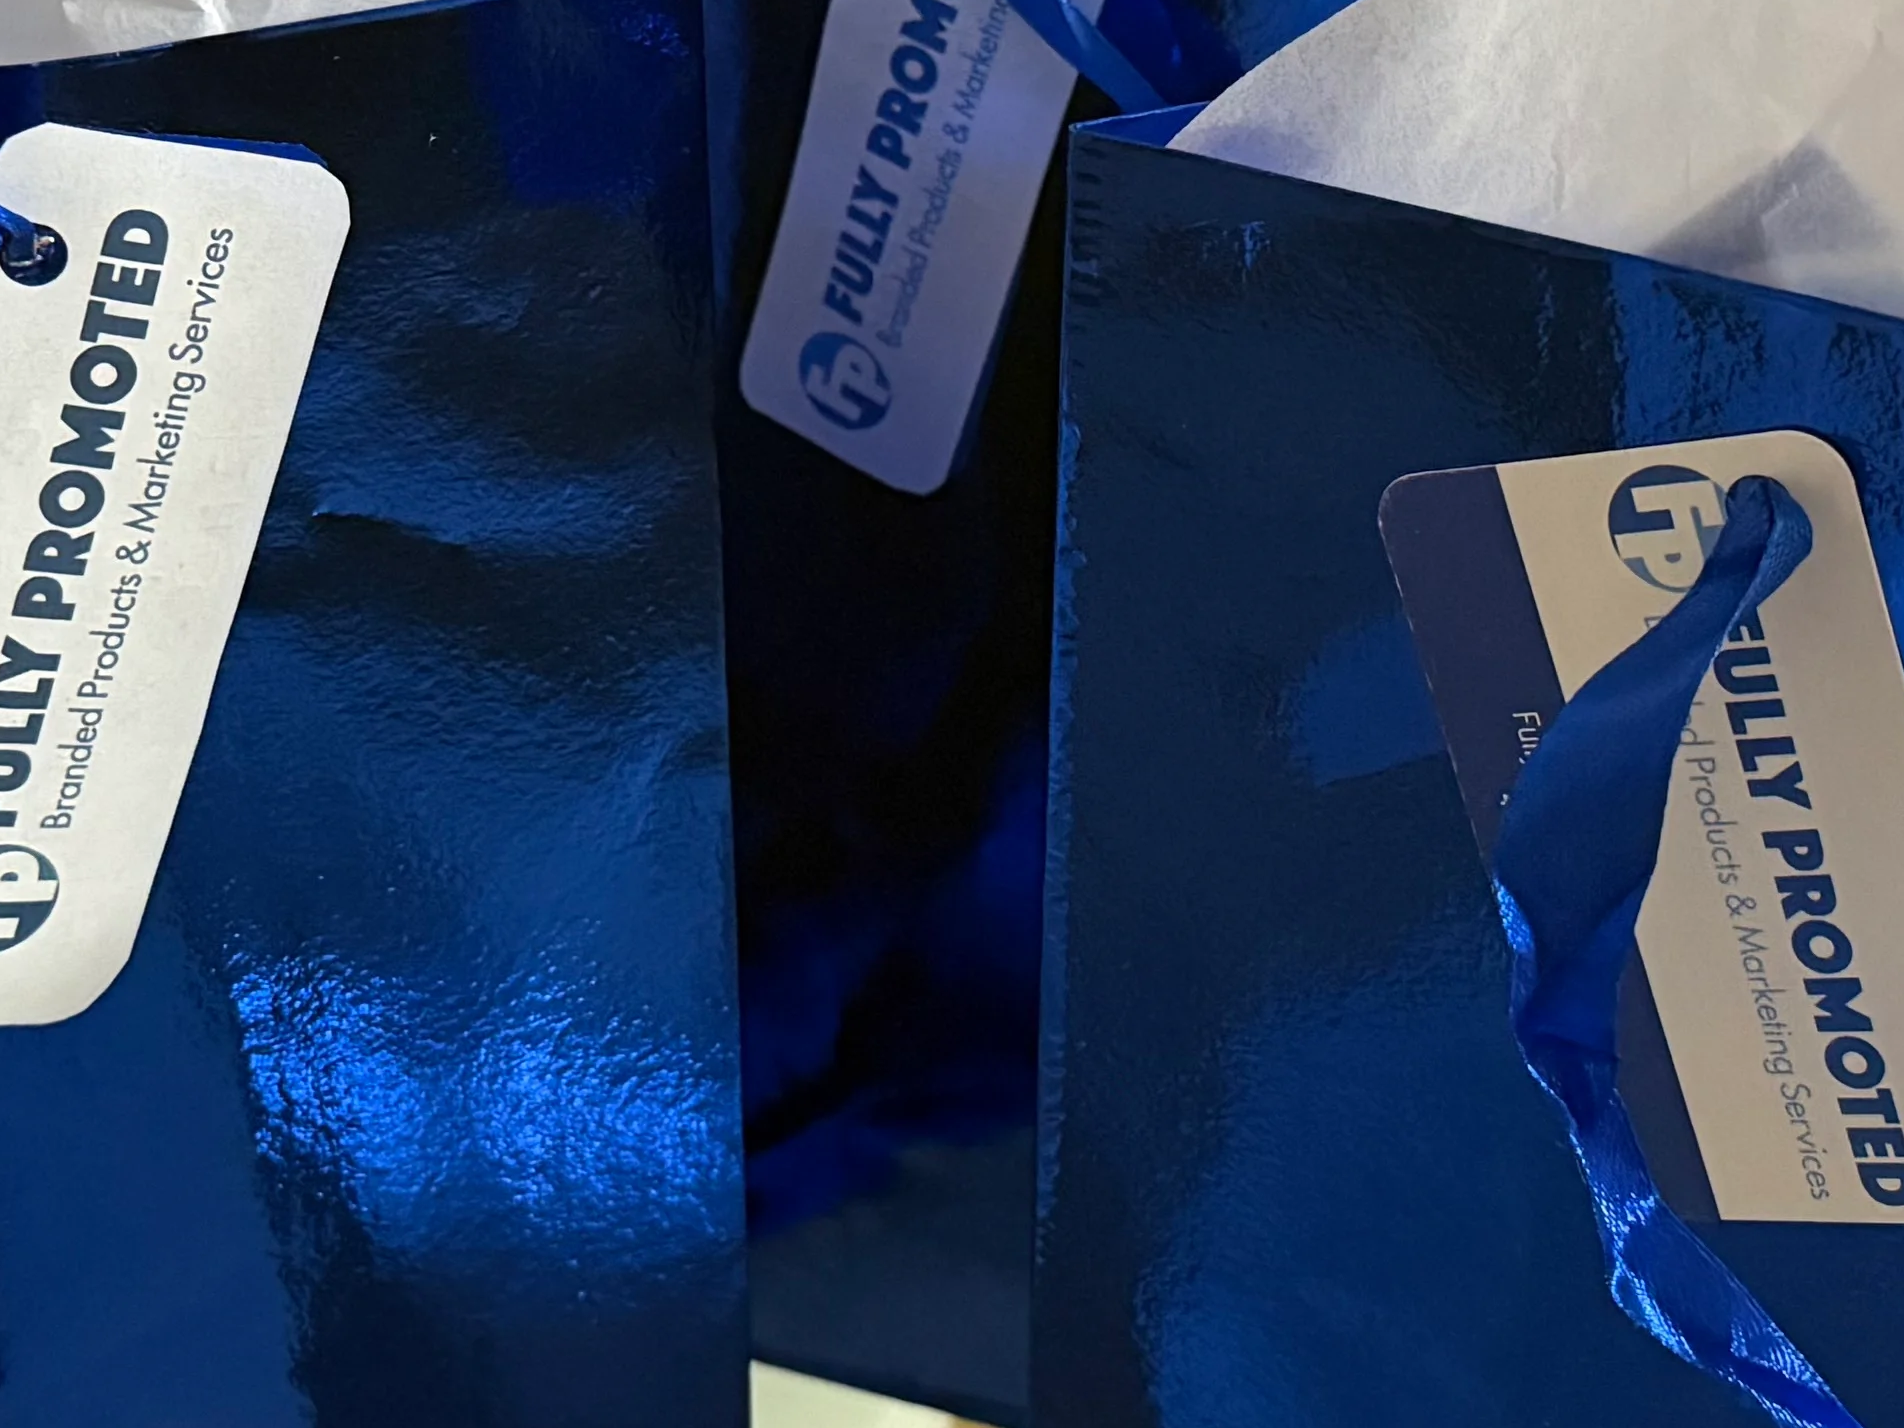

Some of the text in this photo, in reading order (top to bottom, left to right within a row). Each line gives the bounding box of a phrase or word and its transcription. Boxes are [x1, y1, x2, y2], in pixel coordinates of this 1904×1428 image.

[823, 164, 899, 326] FULLY
[907, 148, 963, 249] Products
[943, 122, 970, 143] &
[12, 208, 171, 620] PROMOTED
[40, 227, 234, 830] Branded Products & Marketing Services
[1688, 756, 1829, 1200] Products & Marketing Services
